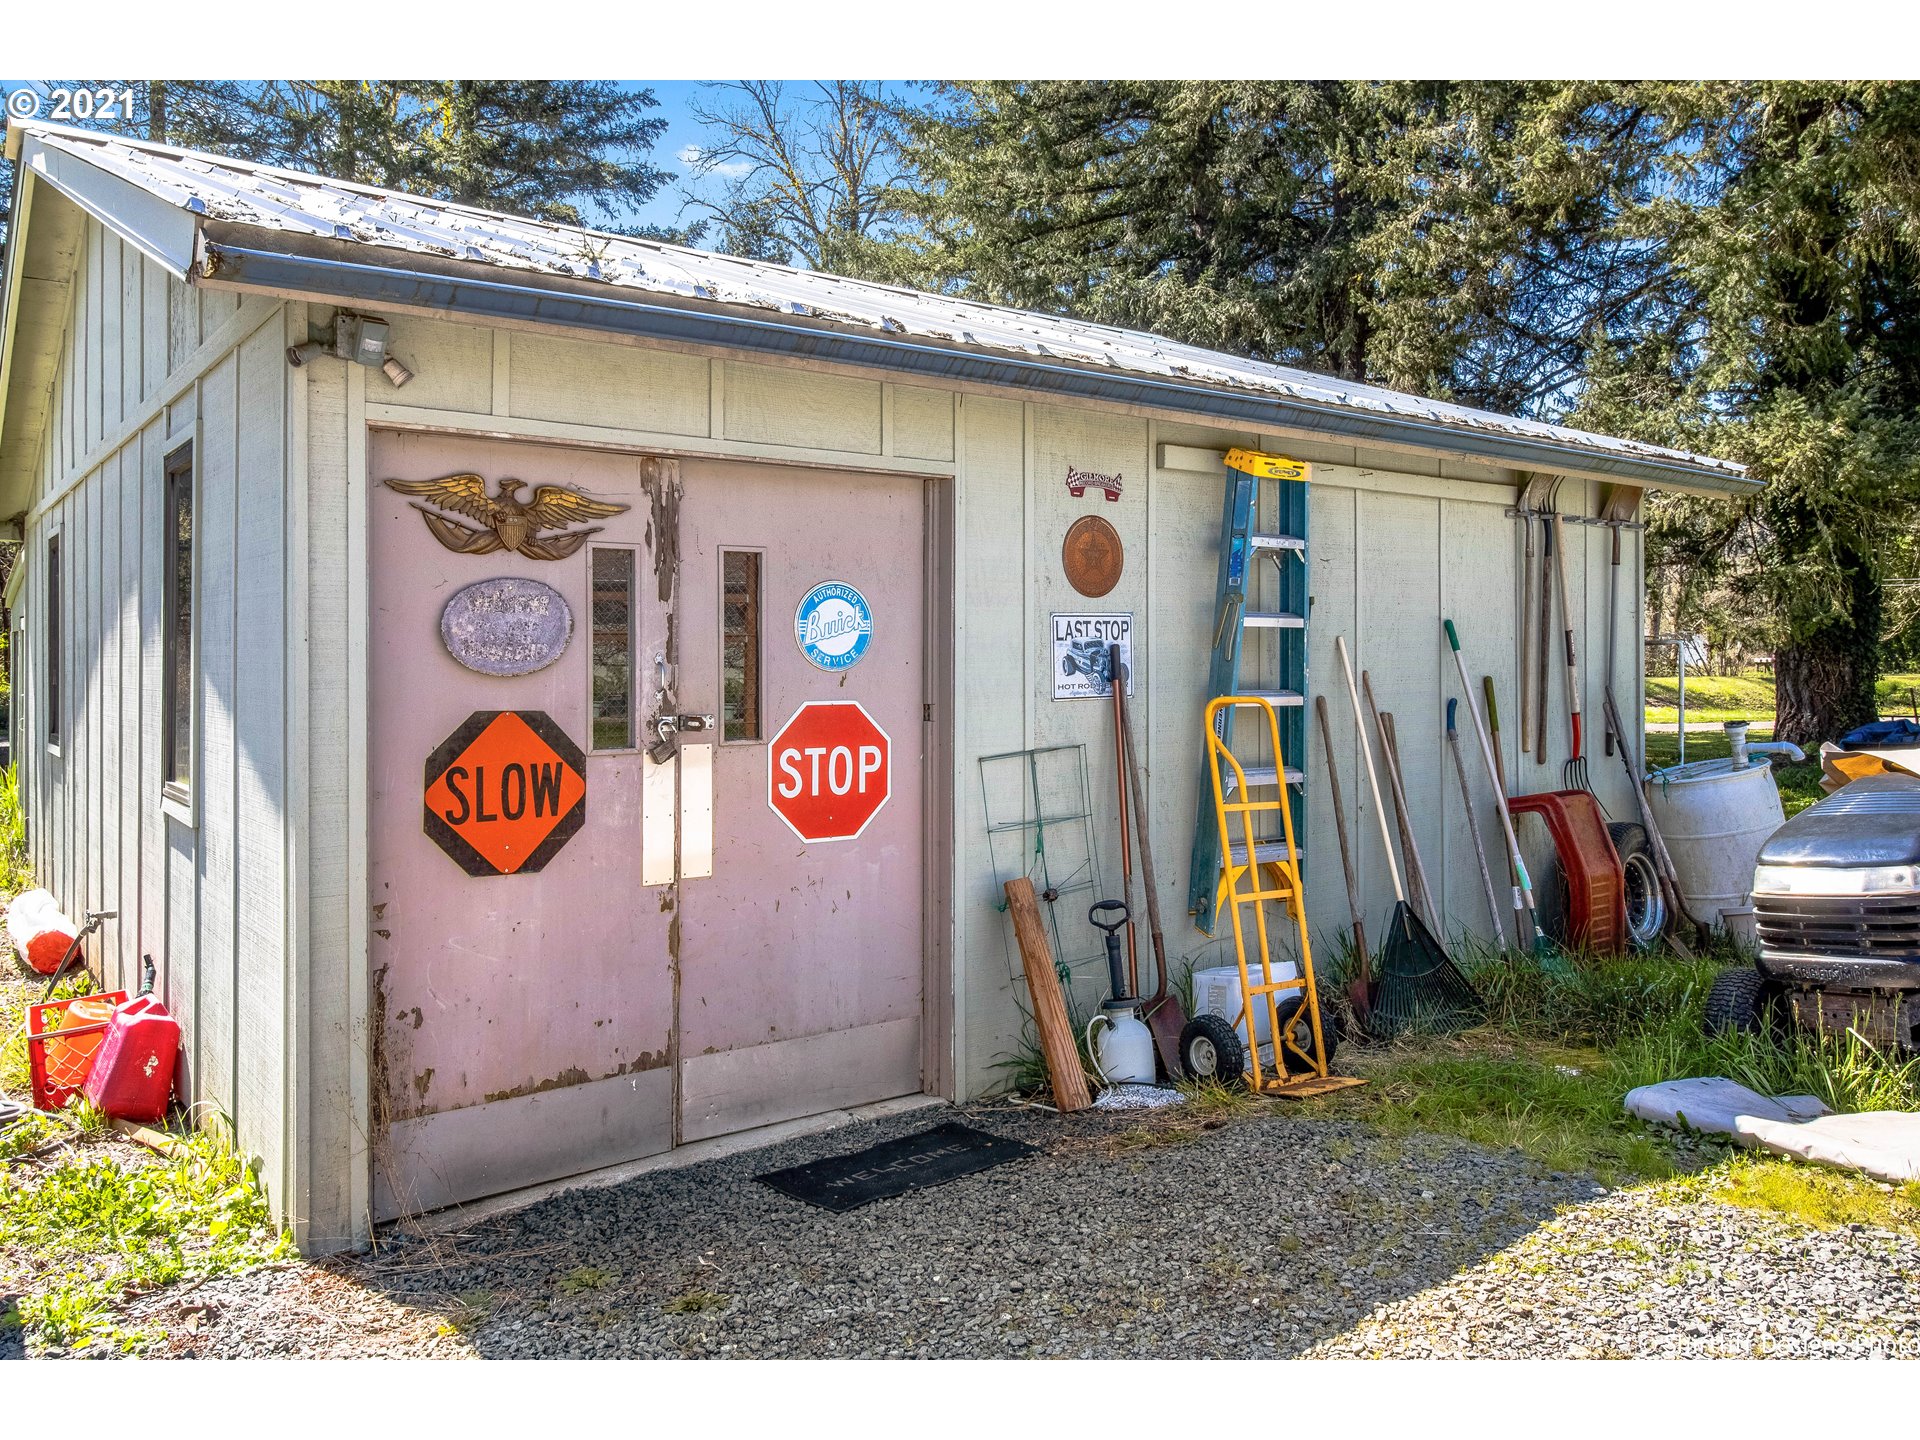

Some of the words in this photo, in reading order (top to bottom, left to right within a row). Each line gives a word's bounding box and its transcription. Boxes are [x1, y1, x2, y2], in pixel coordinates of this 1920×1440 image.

[813, 587, 858, 604] AUTHORIZED
[804, 604, 867, 645] Buick
[1055, 620, 1092, 641] LAST
[1094, 620, 1129, 641] STOP
[811, 648, 859, 666] SERVICE
[778, 745, 883, 799] STOP
[445, 761, 563, 825] SLOW
[826, 1144, 971, 1188] WELCOME
